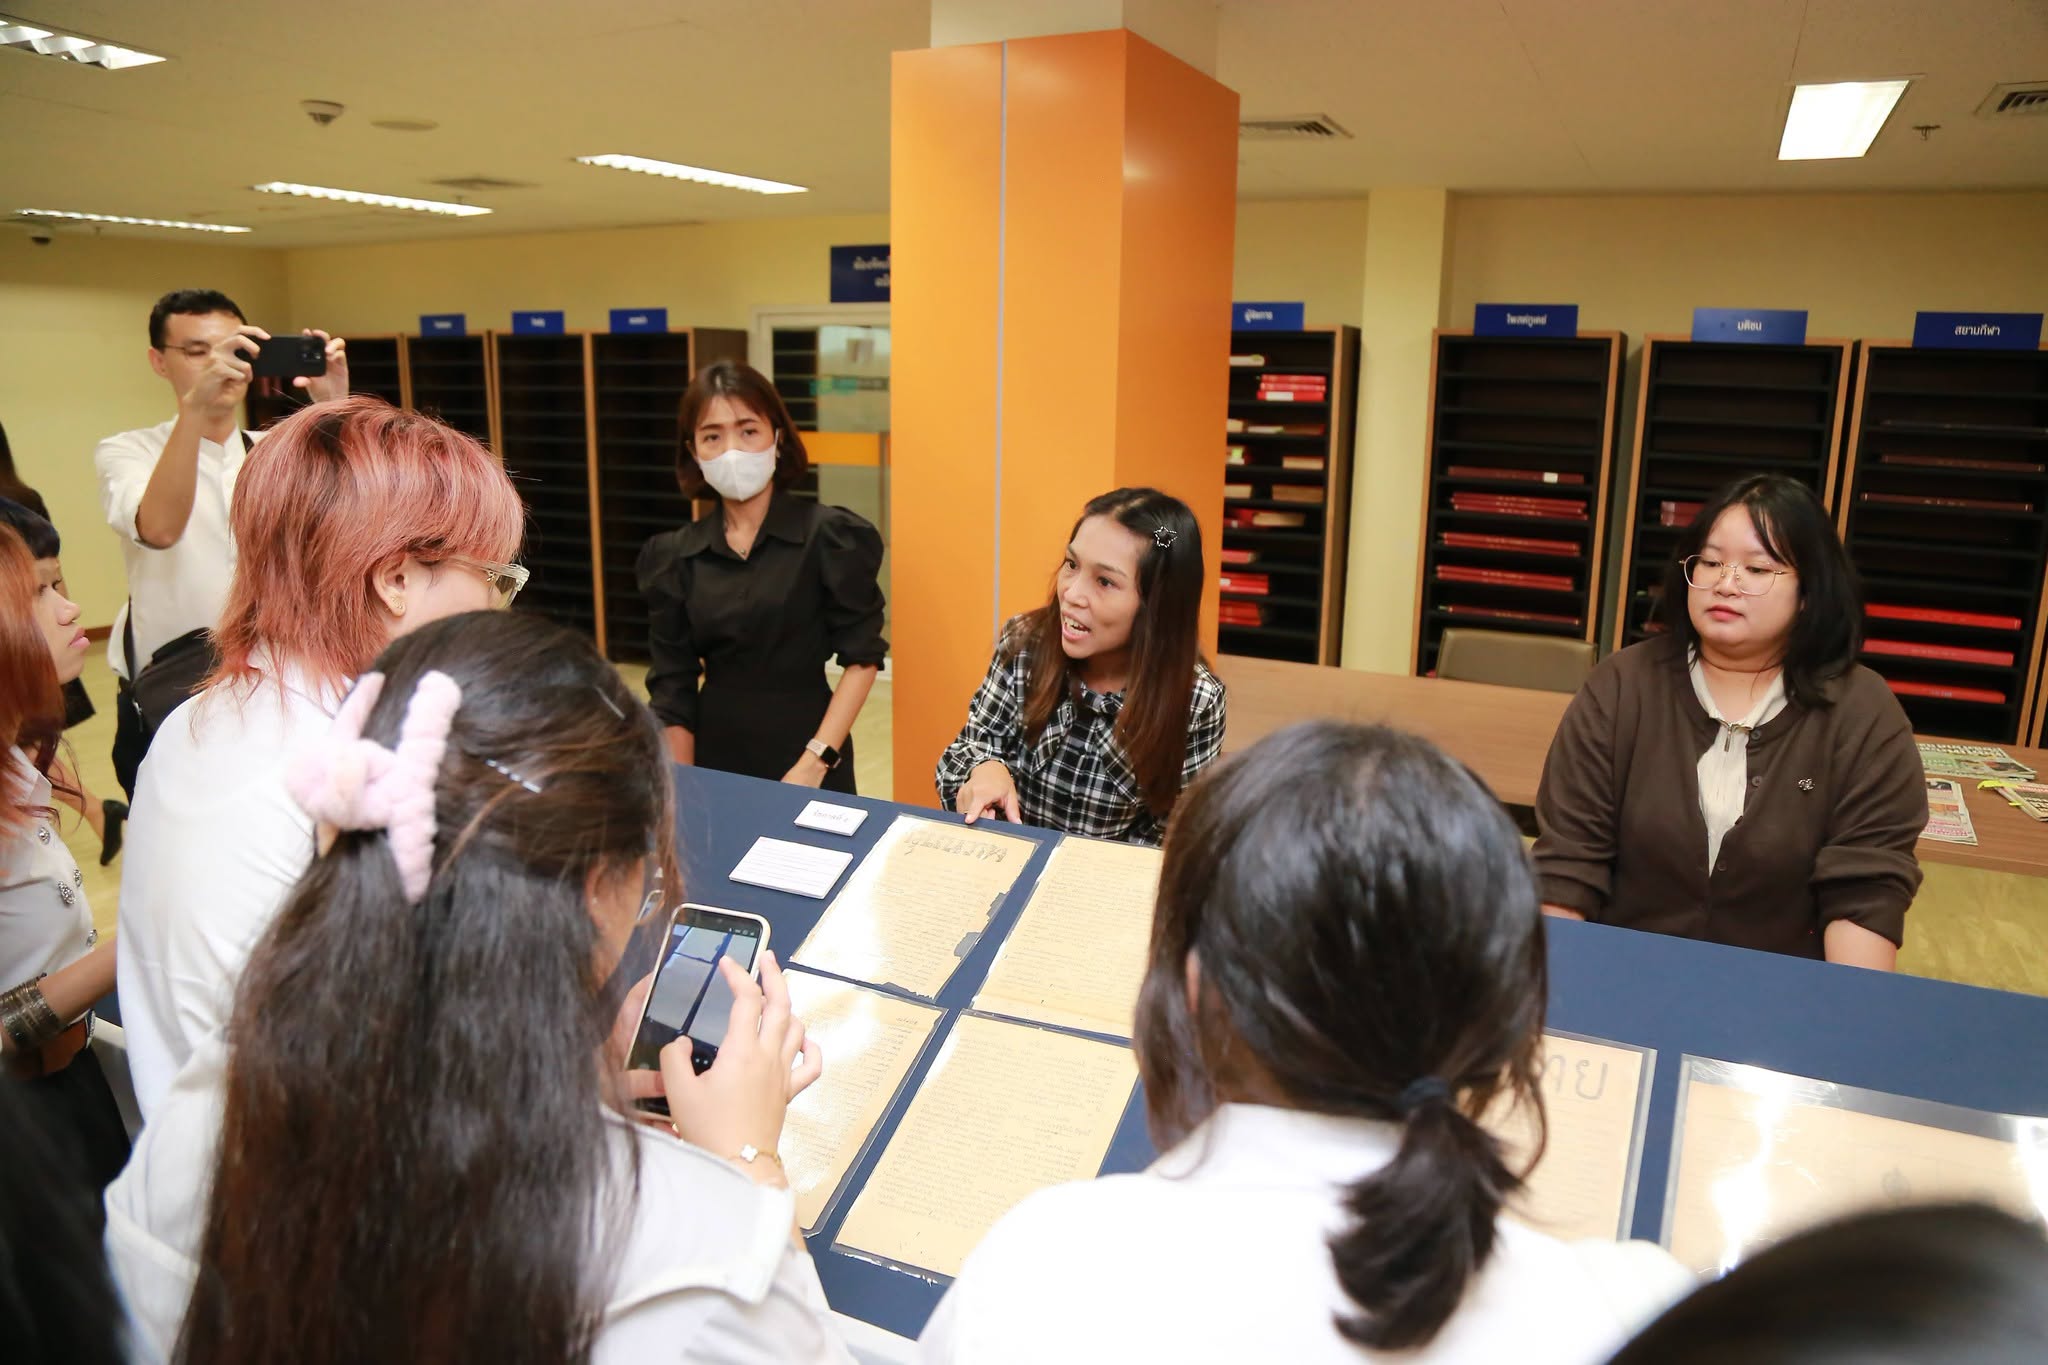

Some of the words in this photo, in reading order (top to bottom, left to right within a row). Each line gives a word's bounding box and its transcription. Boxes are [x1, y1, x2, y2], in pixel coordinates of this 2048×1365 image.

[1737, 319, 1762, 331] มติชน
[1954, 323, 2001, 336] สยามกีฬา
